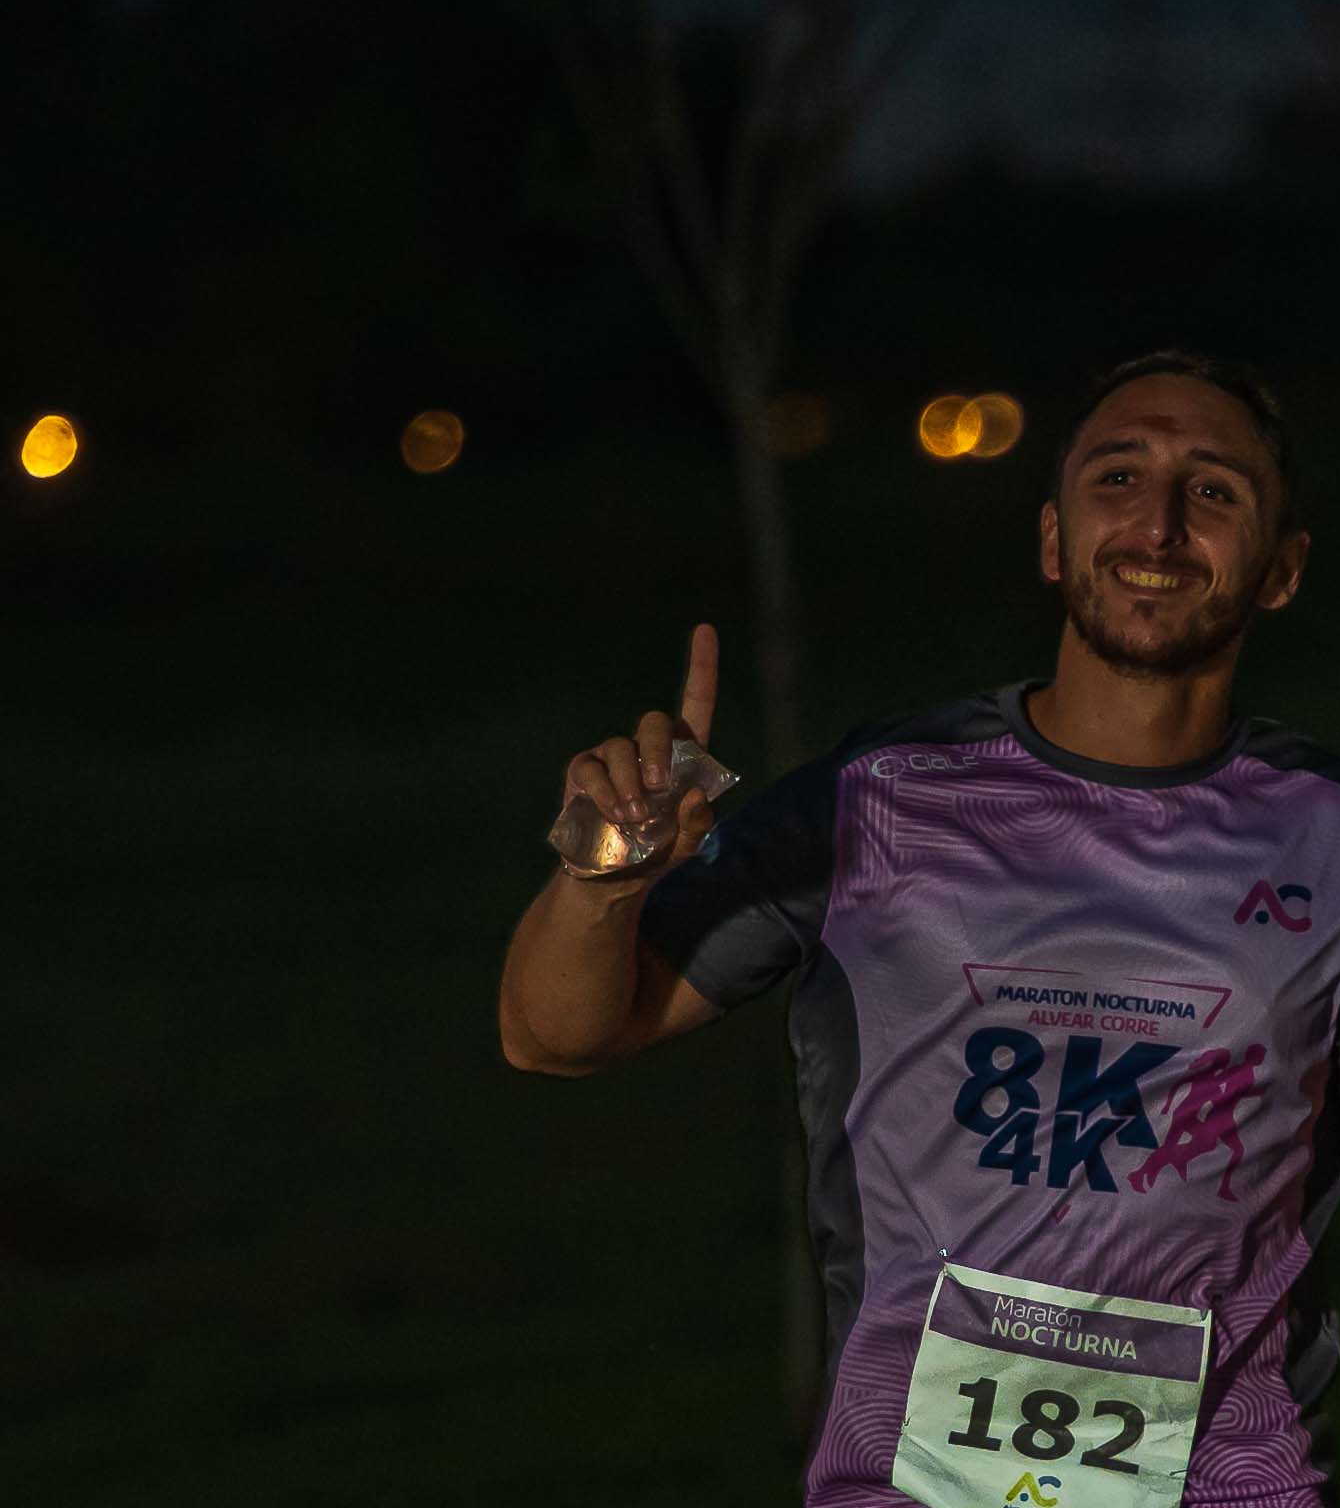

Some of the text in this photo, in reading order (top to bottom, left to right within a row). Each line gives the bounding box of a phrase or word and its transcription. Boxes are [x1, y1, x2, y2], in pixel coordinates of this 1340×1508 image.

[996, 986, 1195, 1020] MARATON NOCTURNA
[1027, 1010, 1160, 1036] ALVEAR CORRE
[953, 1027, 1183, 1150] 8K
[978, 1108, 1120, 1193] 4K
[993, 1295, 1082, 1329] Maratón
[991, 1316, 1137, 1360] NOCTURNA
[948, 1377, 1146, 1475] 182
